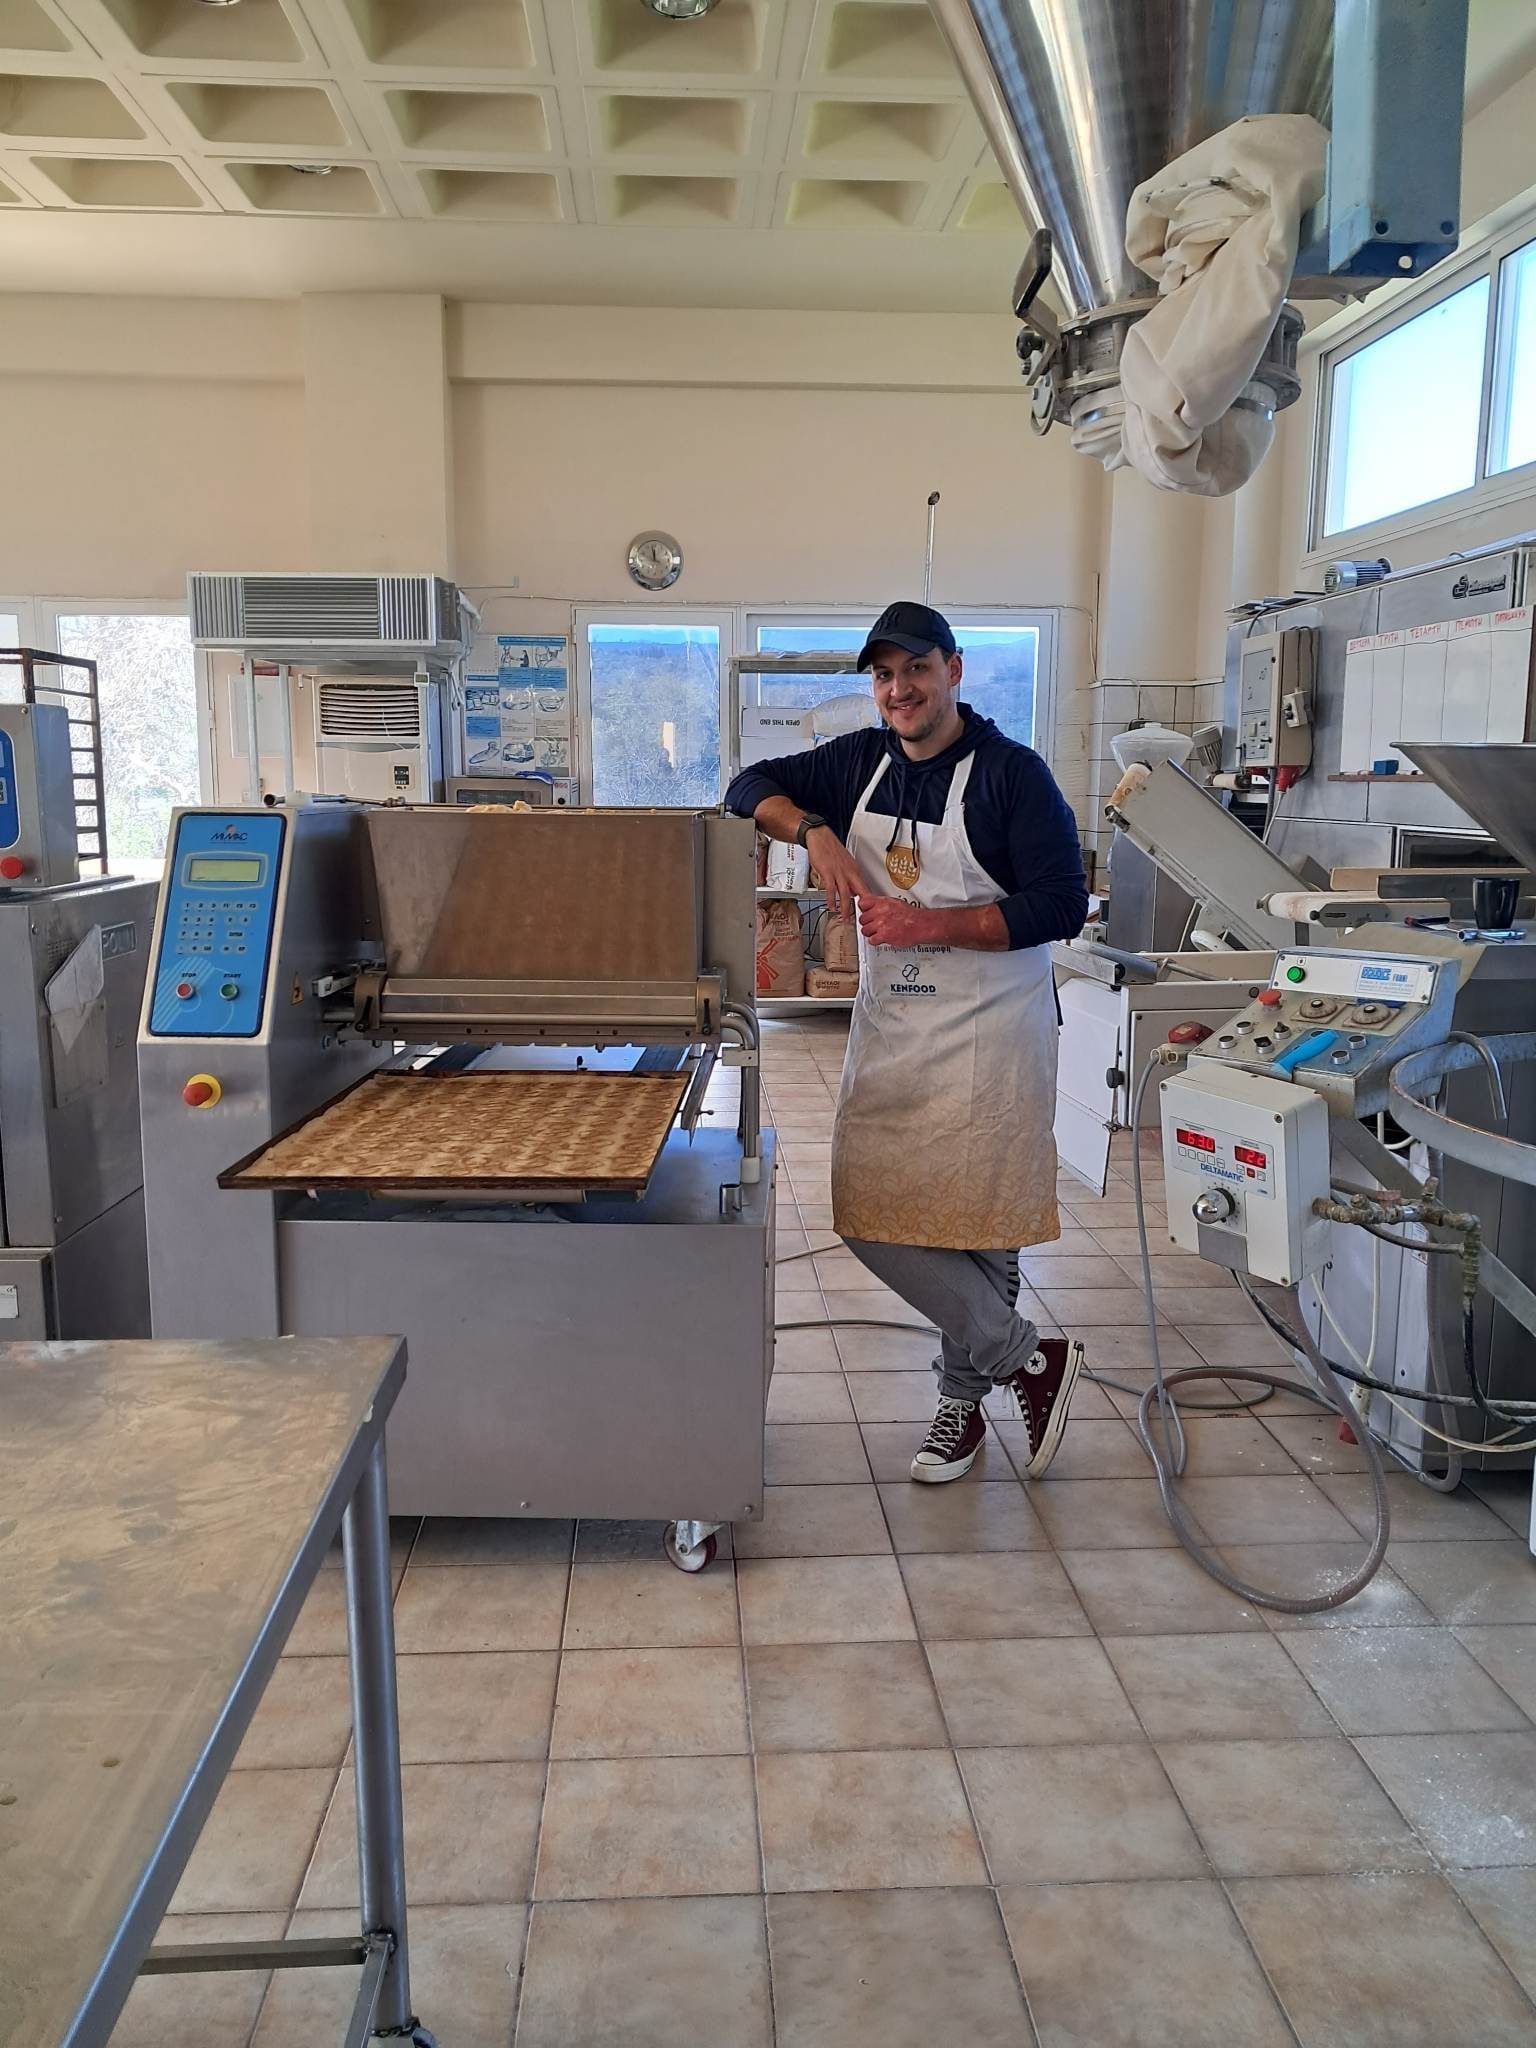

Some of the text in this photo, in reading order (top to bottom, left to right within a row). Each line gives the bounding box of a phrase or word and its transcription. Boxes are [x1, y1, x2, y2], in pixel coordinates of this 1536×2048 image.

[760, 718, 771, 726] END
[785, 719, 801, 727] OPEN
[890, 984, 936, 993] KENFOOD
[1200, 1163, 1244, 1183] DELTAMATIC
